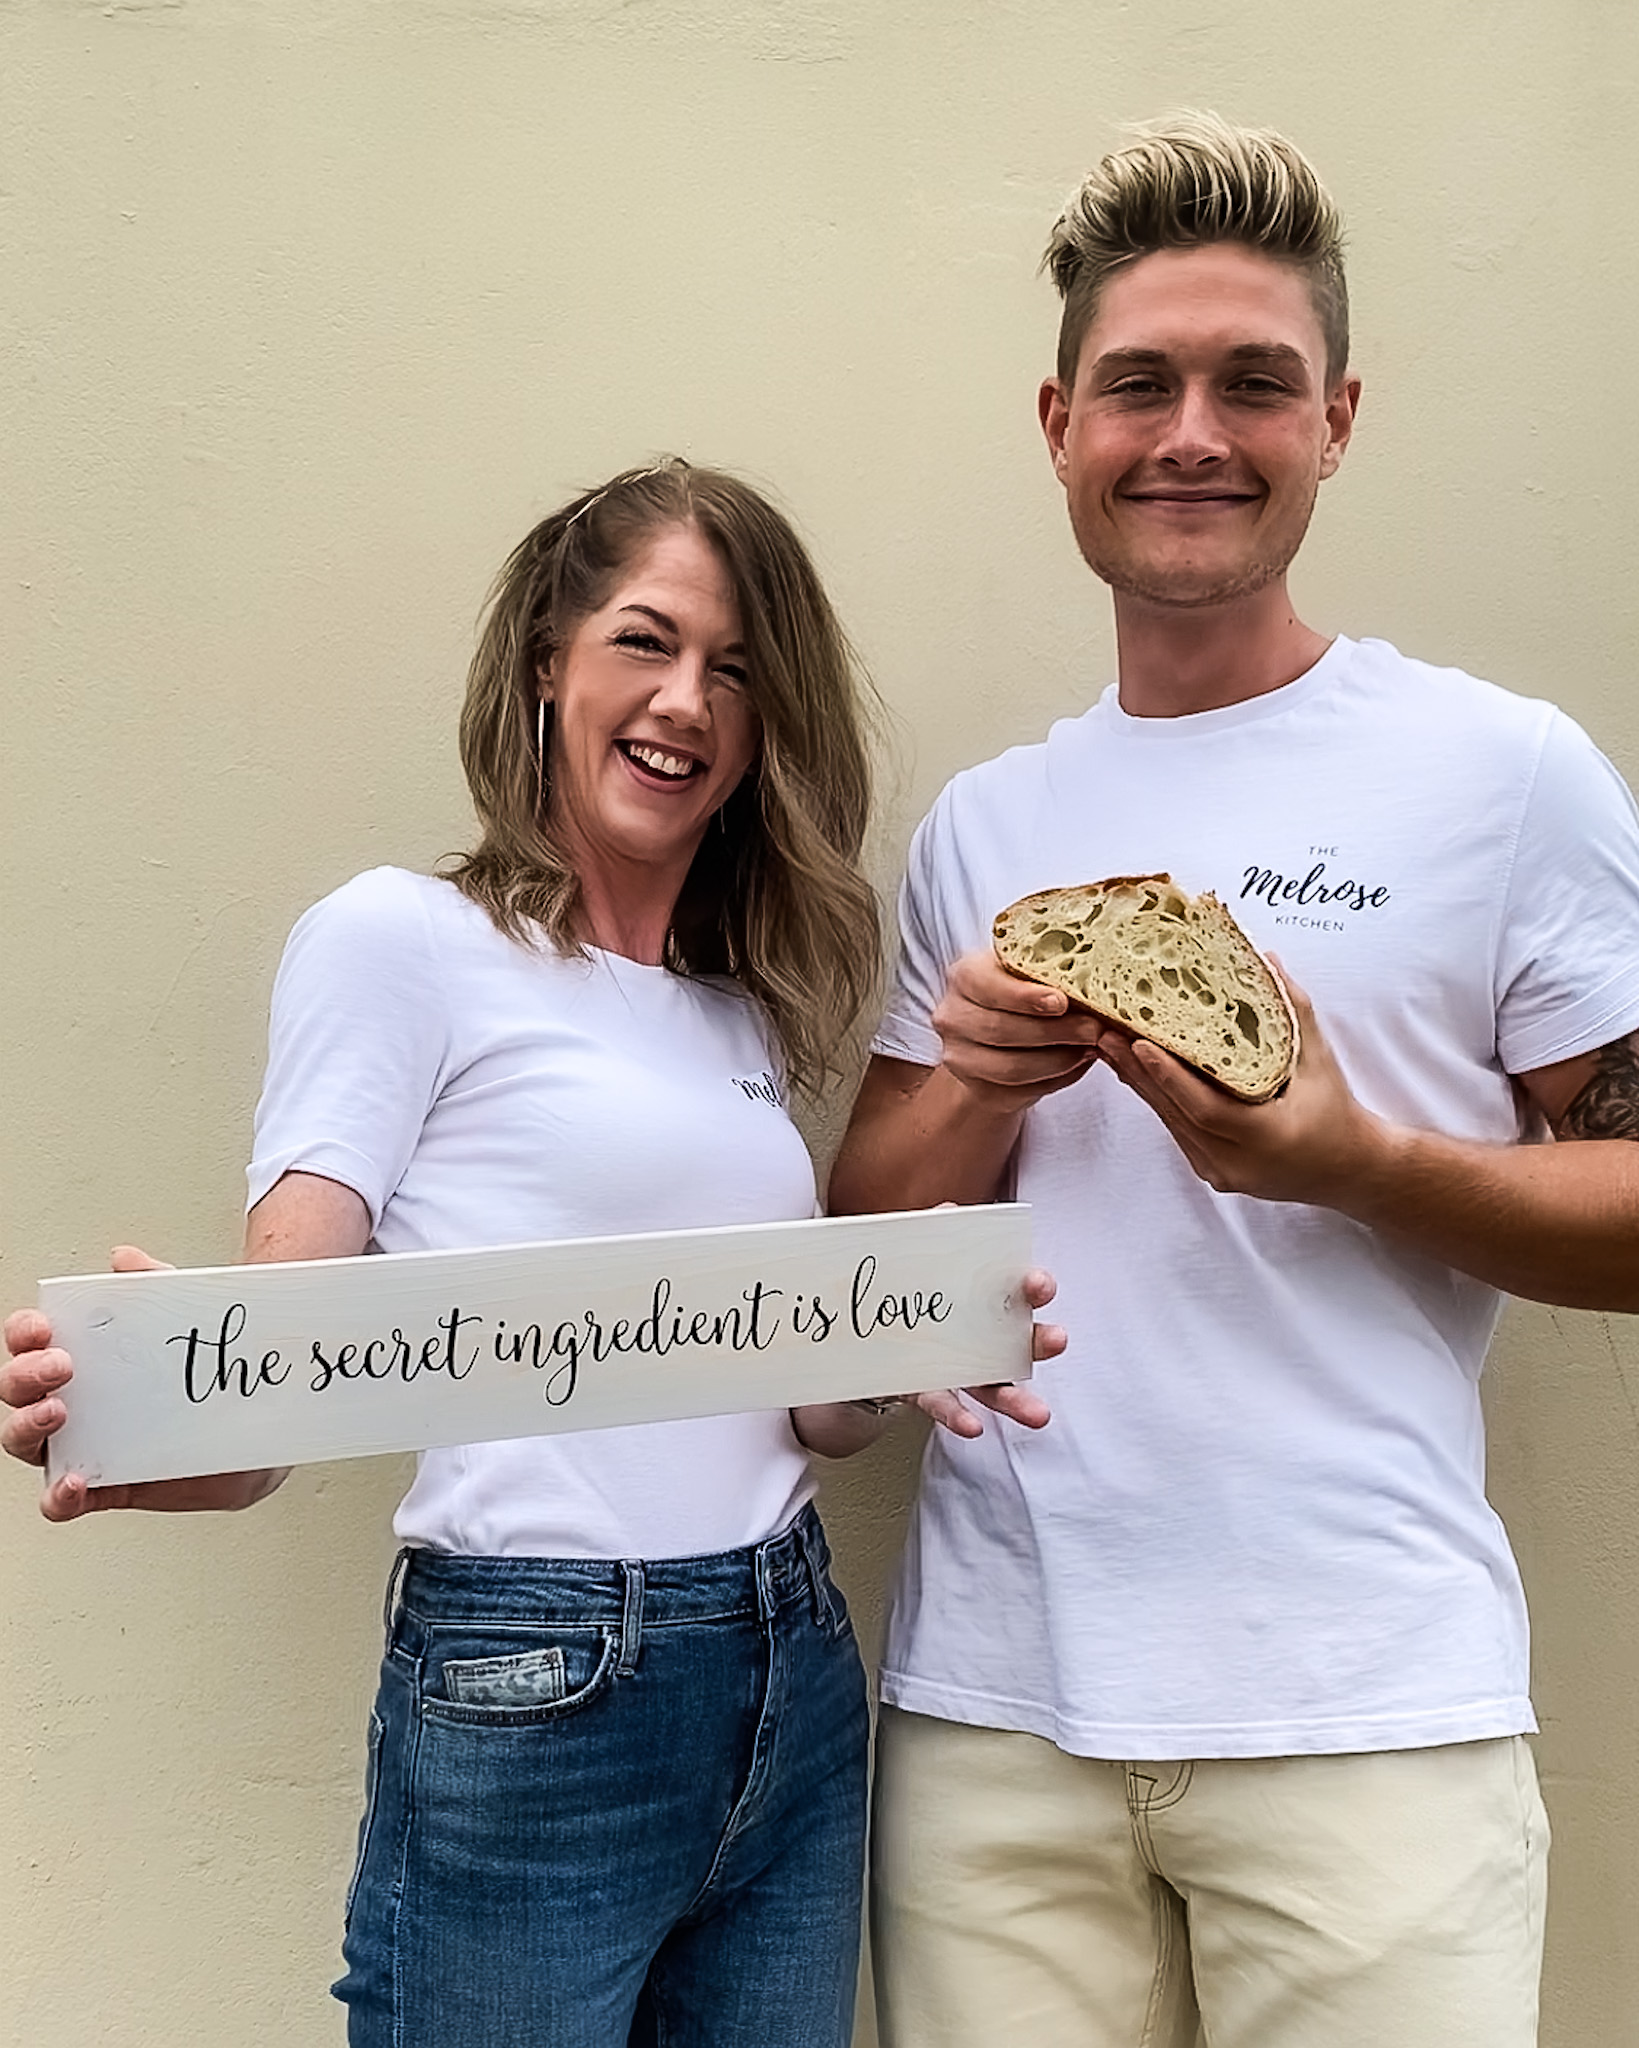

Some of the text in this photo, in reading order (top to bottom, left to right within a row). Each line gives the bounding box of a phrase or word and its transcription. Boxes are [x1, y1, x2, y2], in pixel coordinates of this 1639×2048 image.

[1308, 846, 1340, 857] THE
[1239, 862, 1391, 911] Melrose
[1275, 915, 1345, 932] KITCHEN
[166, 1255, 953, 1406] the secret ingredient is love
